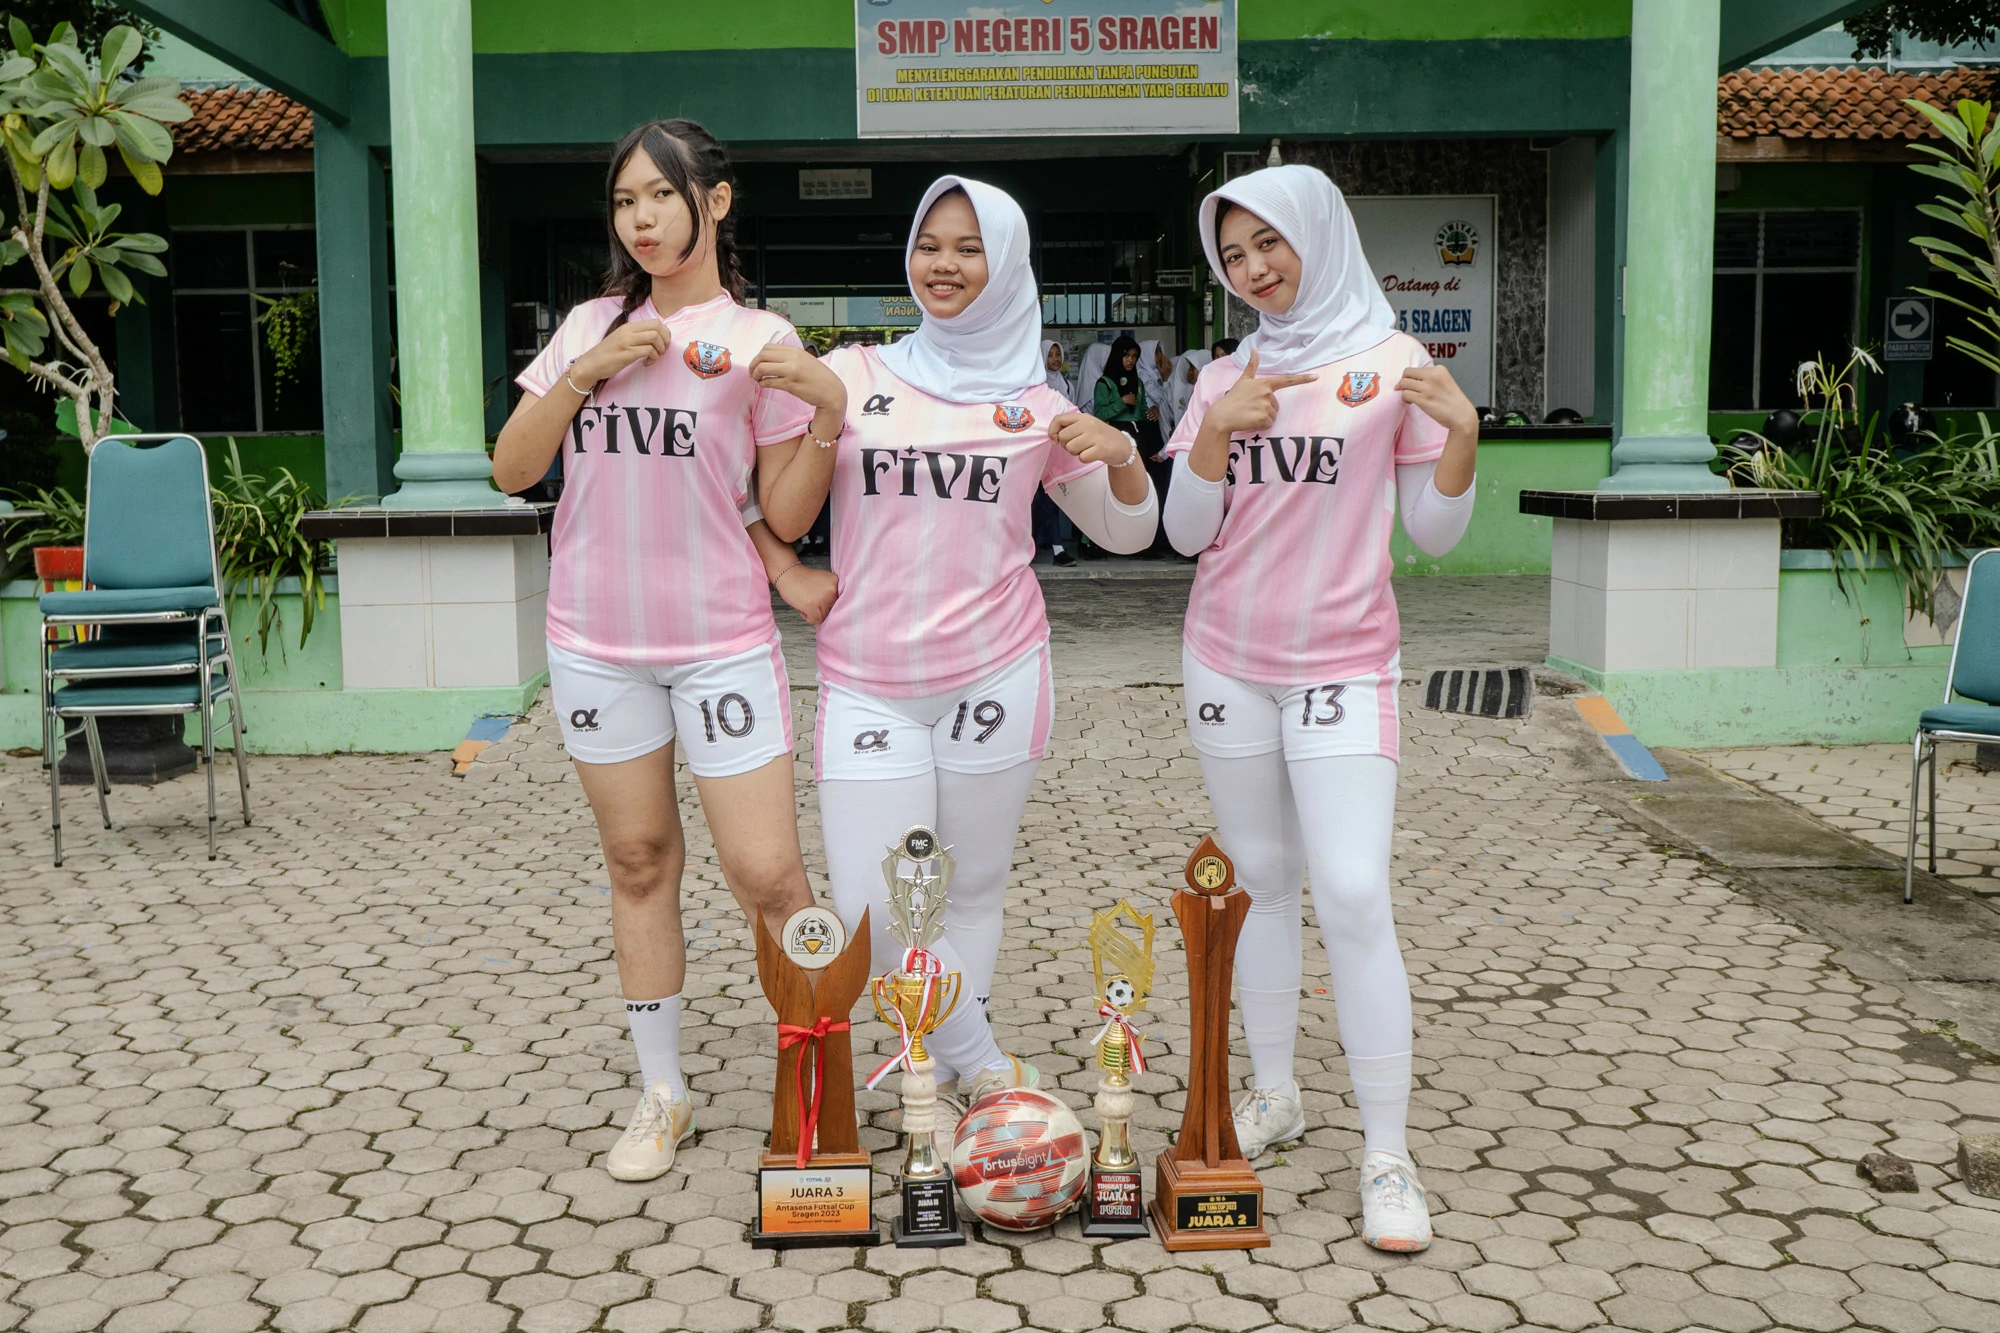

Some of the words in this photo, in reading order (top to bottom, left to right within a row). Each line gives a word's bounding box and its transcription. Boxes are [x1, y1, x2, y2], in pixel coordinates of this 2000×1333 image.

[877, 19, 946, 55] SMP
[954, 18, 1061, 53] NEGERI
[1070, 17, 1090, 52] 5
[1099, 15, 1219, 51] SRAGEN
[896, 66, 1020, 83] MENYELENGGARAKAN
[1022, 65, 1095, 81] PENDIDIKAN
[1096, 64, 1133, 80] TANPA
[1135, 64, 1198, 79] PUNGUTAN
[867, 87, 881, 102] DI
[882, 87, 913, 102] LUAR
[915, 86, 981, 101] KETENTUAN
[984, 85, 1051, 100] PERATURAN
[1054, 84, 1141, 99] PERUNDANGAN
[1142, 83, 1173, 98] YANG
[1175, 82, 1229, 98] BERLAKU
[1382, 275, 1440, 296] Datang
[1443, 276, 1461, 291] di
[1399, 309, 1408, 333] 5
[1412, 308, 1472, 334] SRAGEN
[1355, 381, 1364, 389] 5
[1302, 684, 1349, 727] 13
[698, 692, 755, 743] 10
[950, 699, 1006, 744] 19
[911, 839, 928, 847] FMC
[790, 1187, 833, 1198] JUARA
[836, 1186, 844, 1197] 3
[1097, 1191, 1128, 1201] JUARA
[1130, 1192, 1135, 1201] 1
[792, 1211, 819, 1219] Sragen
[1099, 1204, 1132, 1215] PUTRI
[1188, 1214, 1234, 1228] JUARA
[1237, 1213, 1247, 1225] 2
